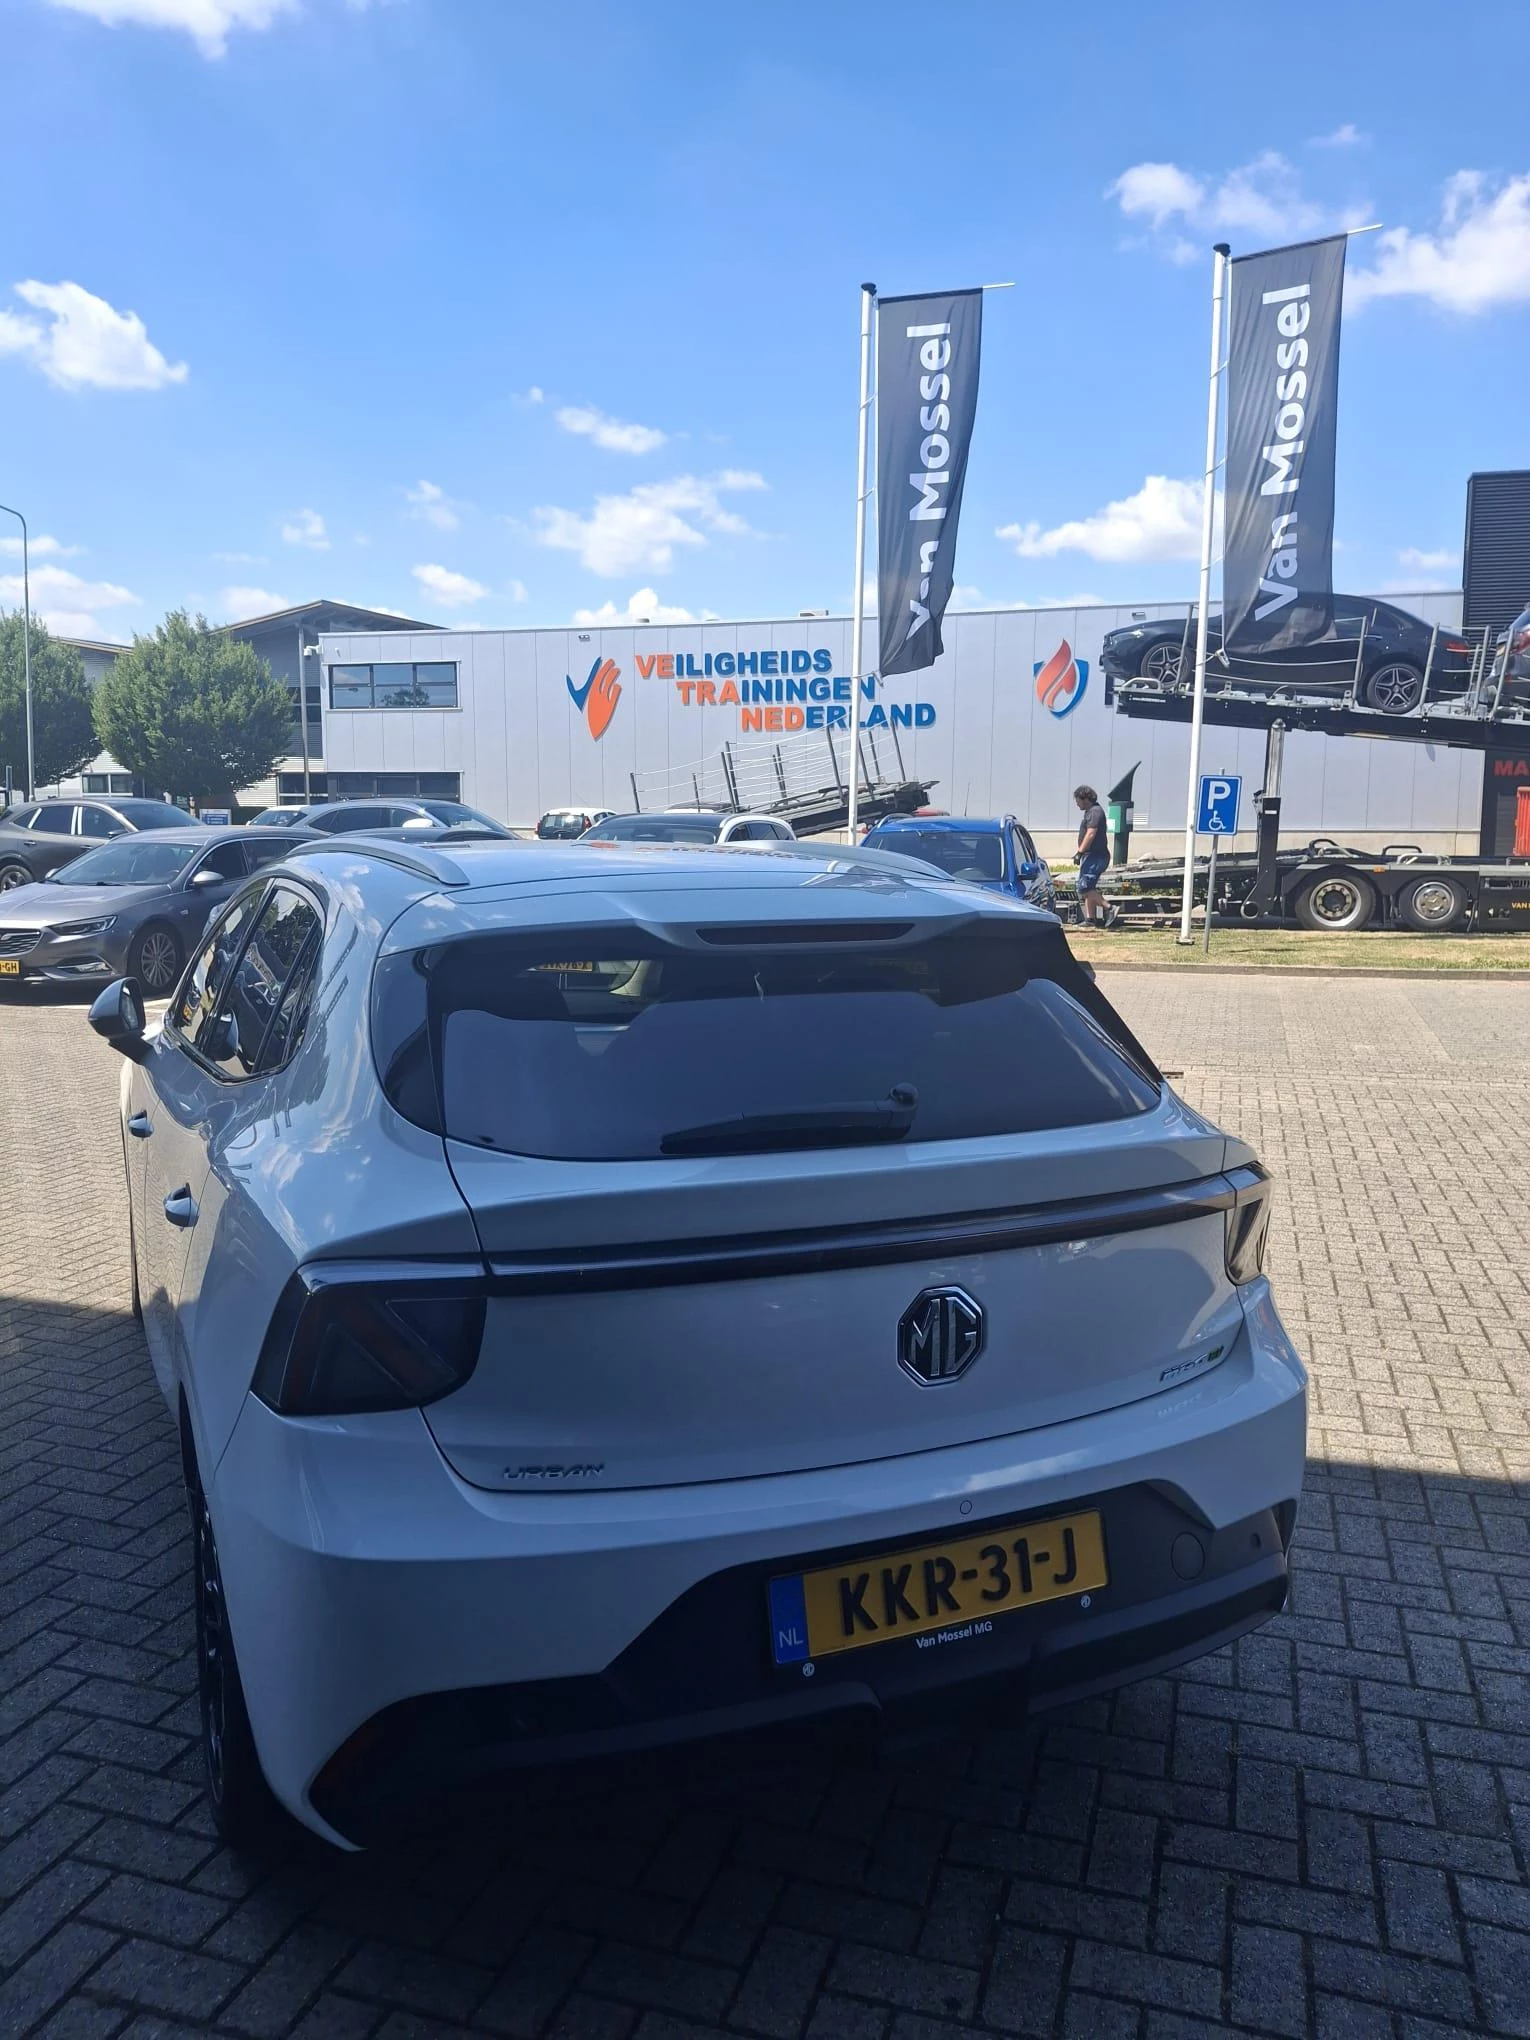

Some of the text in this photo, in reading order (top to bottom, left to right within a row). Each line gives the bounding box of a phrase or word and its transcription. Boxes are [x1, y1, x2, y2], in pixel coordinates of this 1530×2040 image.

[906, 321, 952, 521] Mossel
[1254, 283, 1311, 621] Van Mossel
[635, 648, 832, 679] VEILIGHEIDS
[676, 676, 876, 705] TRAININGEN
[1207, 780, 1231, 810] P
[908, 1296, 978, 1377] MG
[502, 1462, 605, 1481] URBAN
[839, 1527, 1078, 1637] KKR-31-J
[778, 1626, 804, 1649] NL
[915, 1620, 993, 1649] Van Mossel MG
